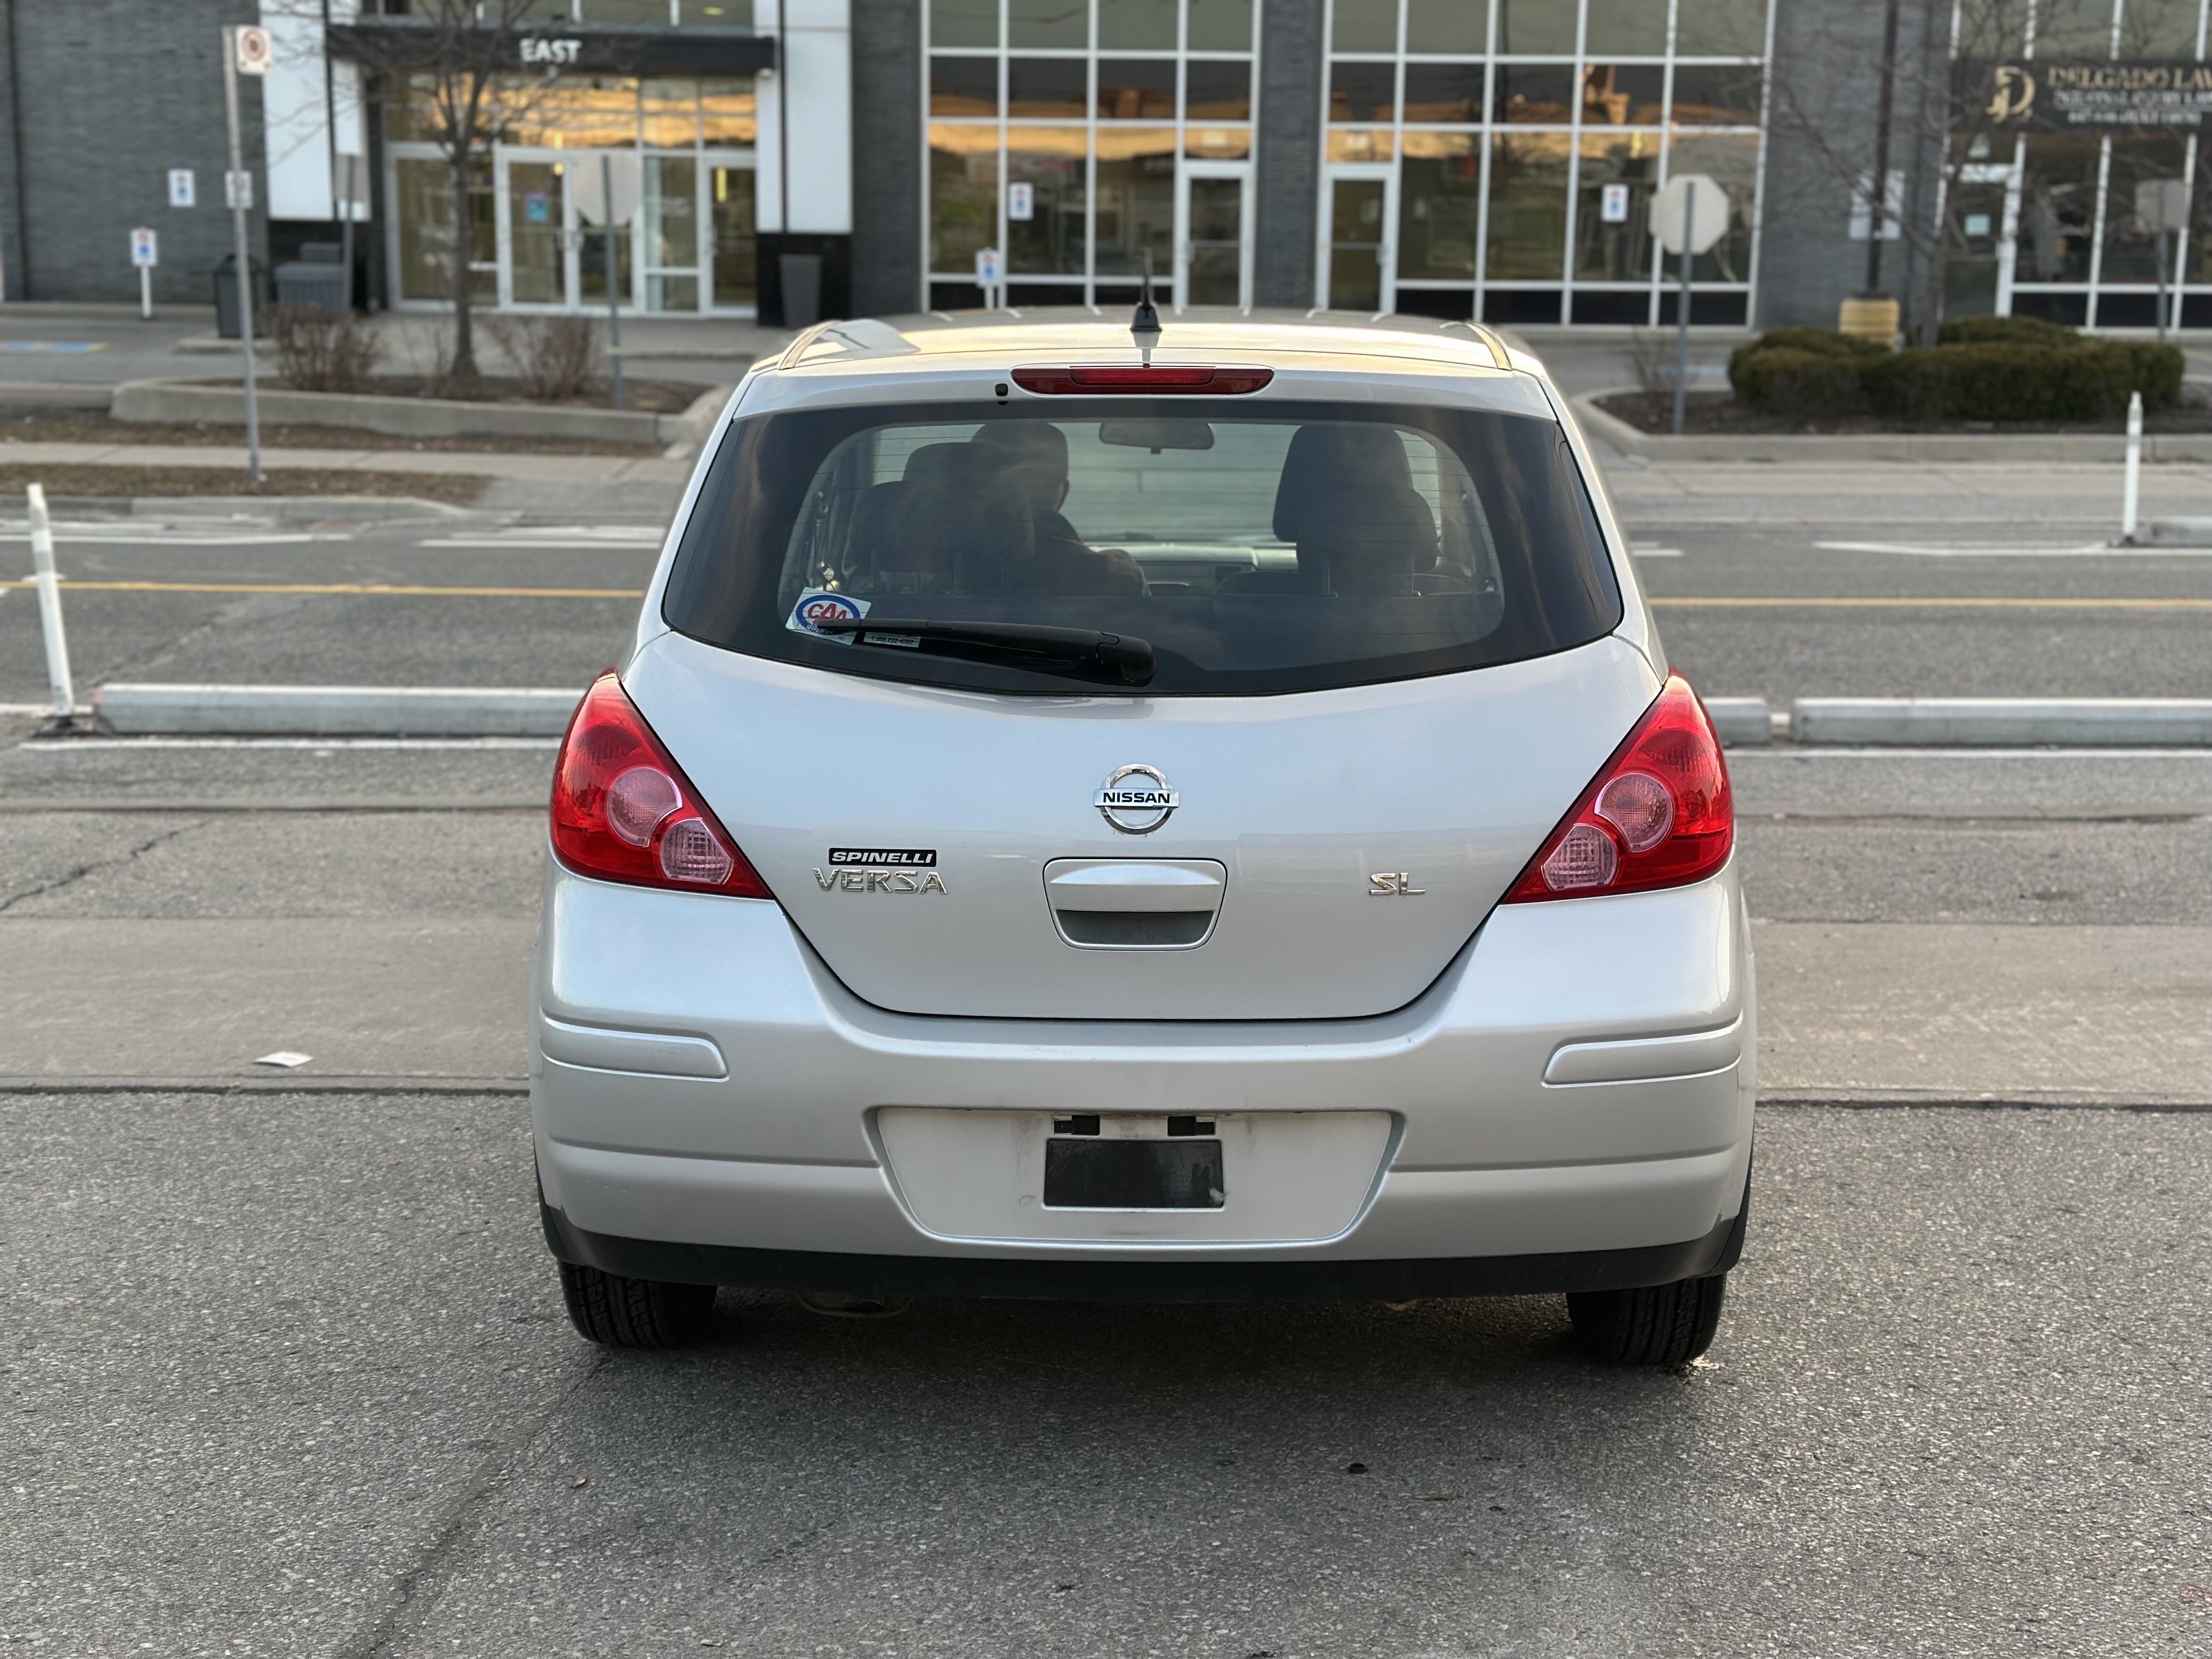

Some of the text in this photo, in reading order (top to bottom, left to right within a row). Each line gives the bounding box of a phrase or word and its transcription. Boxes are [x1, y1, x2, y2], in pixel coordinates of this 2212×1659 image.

[519, 38, 582, 63] EAST
[807, 603, 847, 619] CAA
[1103, 792, 1171, 804] NISSAN
[831, 851, 933, 864] SPINELLI
[812, 868, 948, 895] VERSA
[1369, 872, 1426, 895] SL
